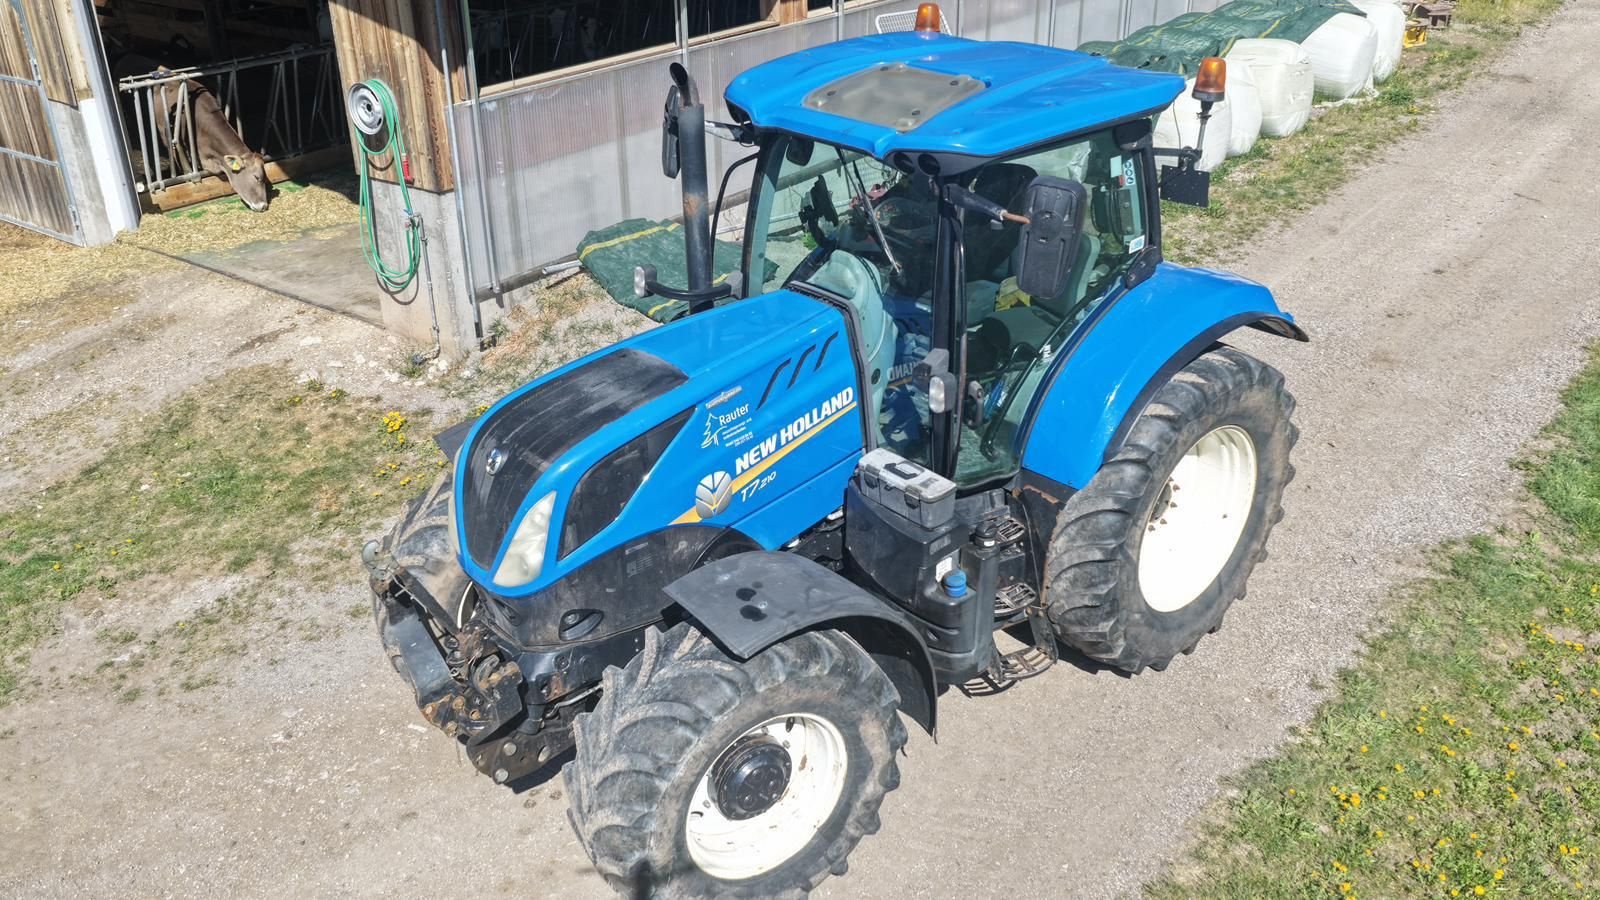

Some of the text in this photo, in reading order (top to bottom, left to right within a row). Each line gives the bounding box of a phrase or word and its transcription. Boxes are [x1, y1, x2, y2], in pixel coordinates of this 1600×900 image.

[719, 403, 749, 426] Rauter
[735, 433, 777, 475] NEW
[780, 386, 853, 446] HOLLAND
